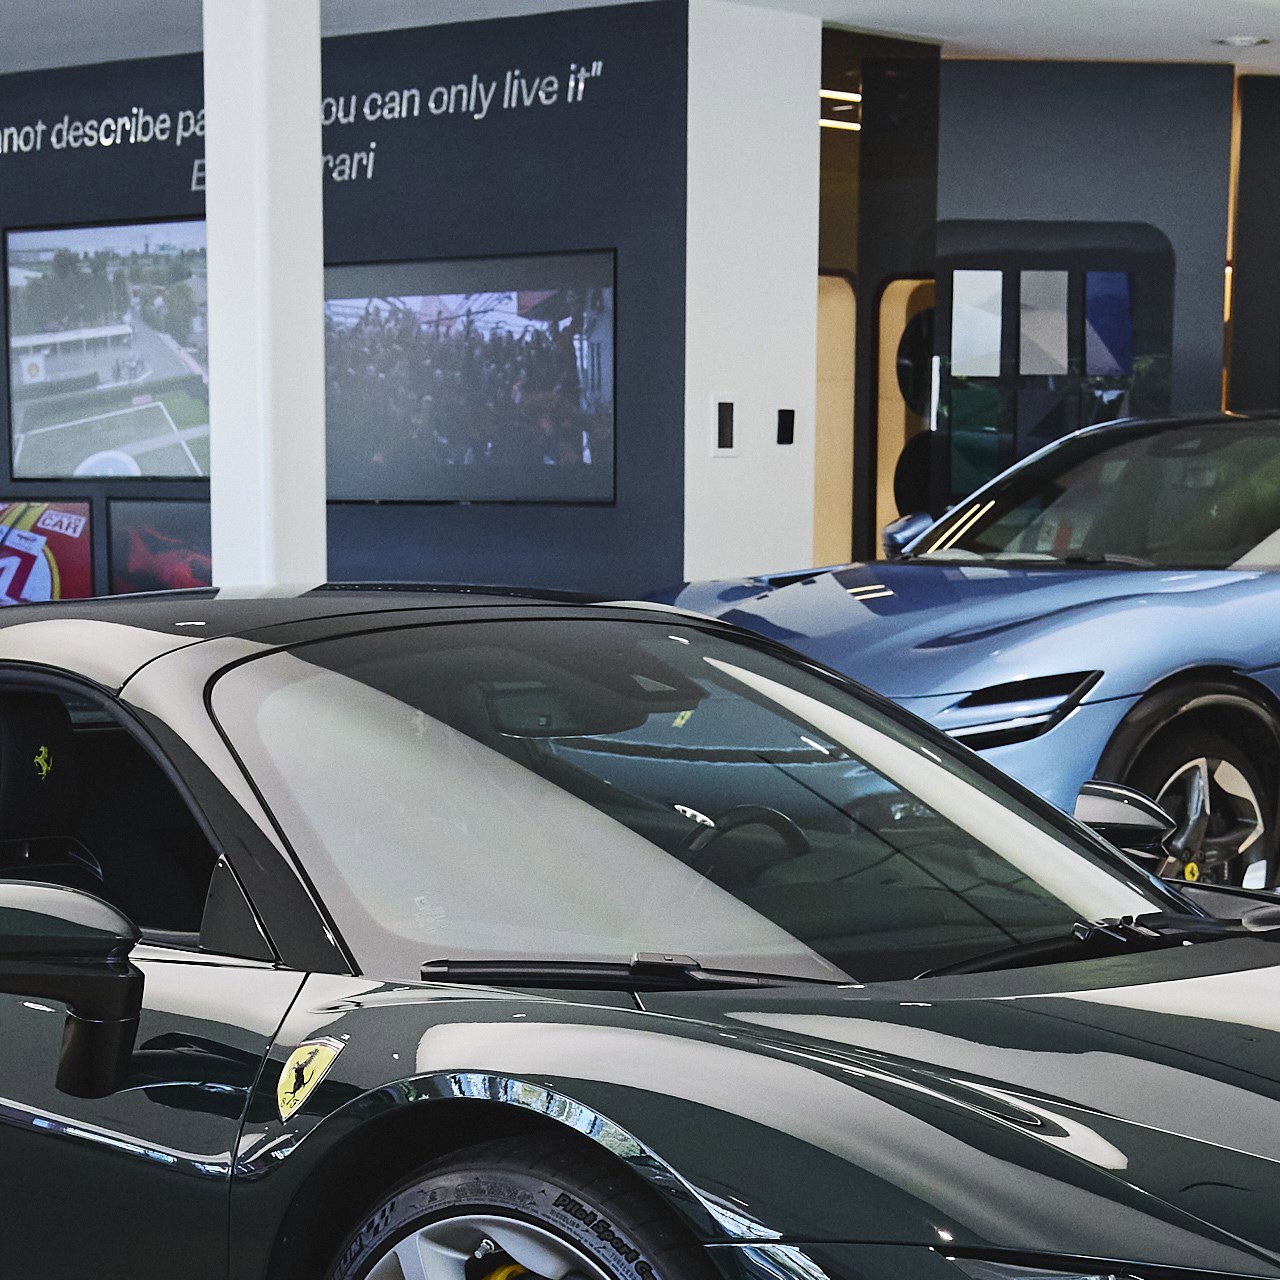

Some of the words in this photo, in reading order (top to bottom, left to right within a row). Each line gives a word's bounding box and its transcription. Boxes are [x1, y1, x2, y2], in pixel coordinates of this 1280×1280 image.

[51, 106, 171, 150] describe
[321, 95, 357, 126] ou
[363, 87, 421, 122] can
[428, 73, 497, 120] only
[502, 69, 560, 109] live
[321, 141, 377, 182] rari
[40, 516, 80, 535] CAR
[552, 1192, 598, 1226] Pilot
[591, 1219, 640, 1264] Sport
